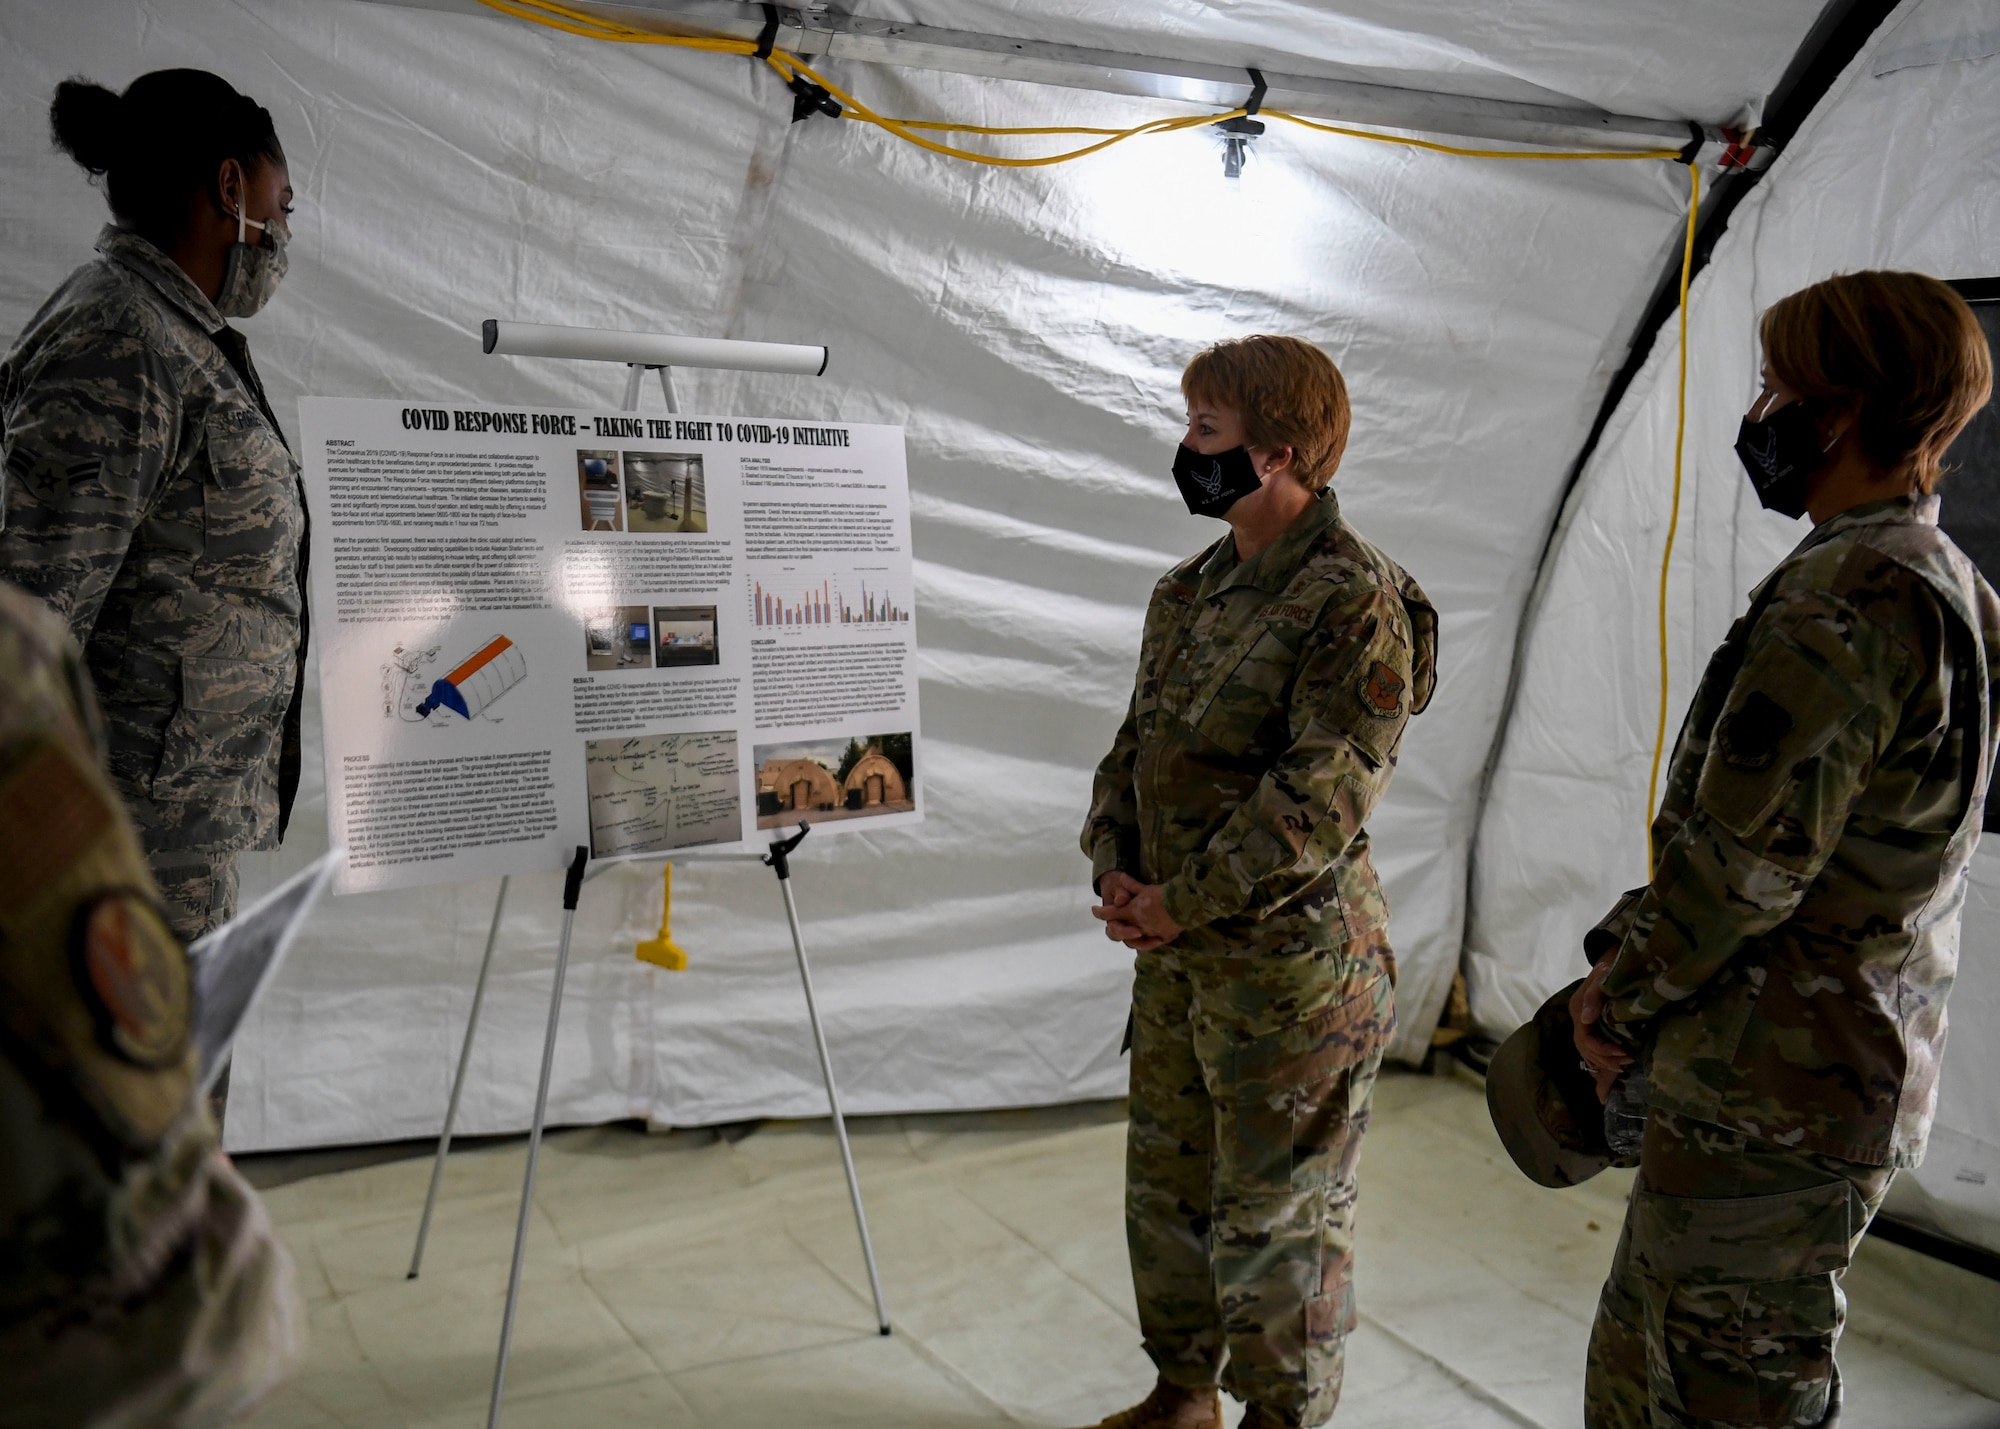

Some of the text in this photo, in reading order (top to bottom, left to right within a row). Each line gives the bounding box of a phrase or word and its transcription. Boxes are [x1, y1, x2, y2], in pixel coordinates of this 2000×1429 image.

[402, 409, 449, 430] COVID
[454, 411, 528, 434] RESPONSE
[532, 414, 576, 436] FORCE
[594, 417, 643, 438] TAKING
[647, 420, 672, 440] THE
[676, 421, 712, 441] FIGHT
[716, 423, 733, 442] TO
[737, 424, 789, 444] COVID-19
[794, 427, 850, 447] INITIATIVE
[407, 450, 429, 459] Response
[515, 454, 534, 462] approach
[327, 458, 345, 466] provide
[437, 460, 469, 468] unprecedented
[382, 467, 404, 475] personnel
[1778, 464, 1794, 477] FORCE
[1221, 488, 1235, 498] FORCE
[1267, 604, 1281, 616] AIR
[1280, 604, 1314, 624] FORCE
